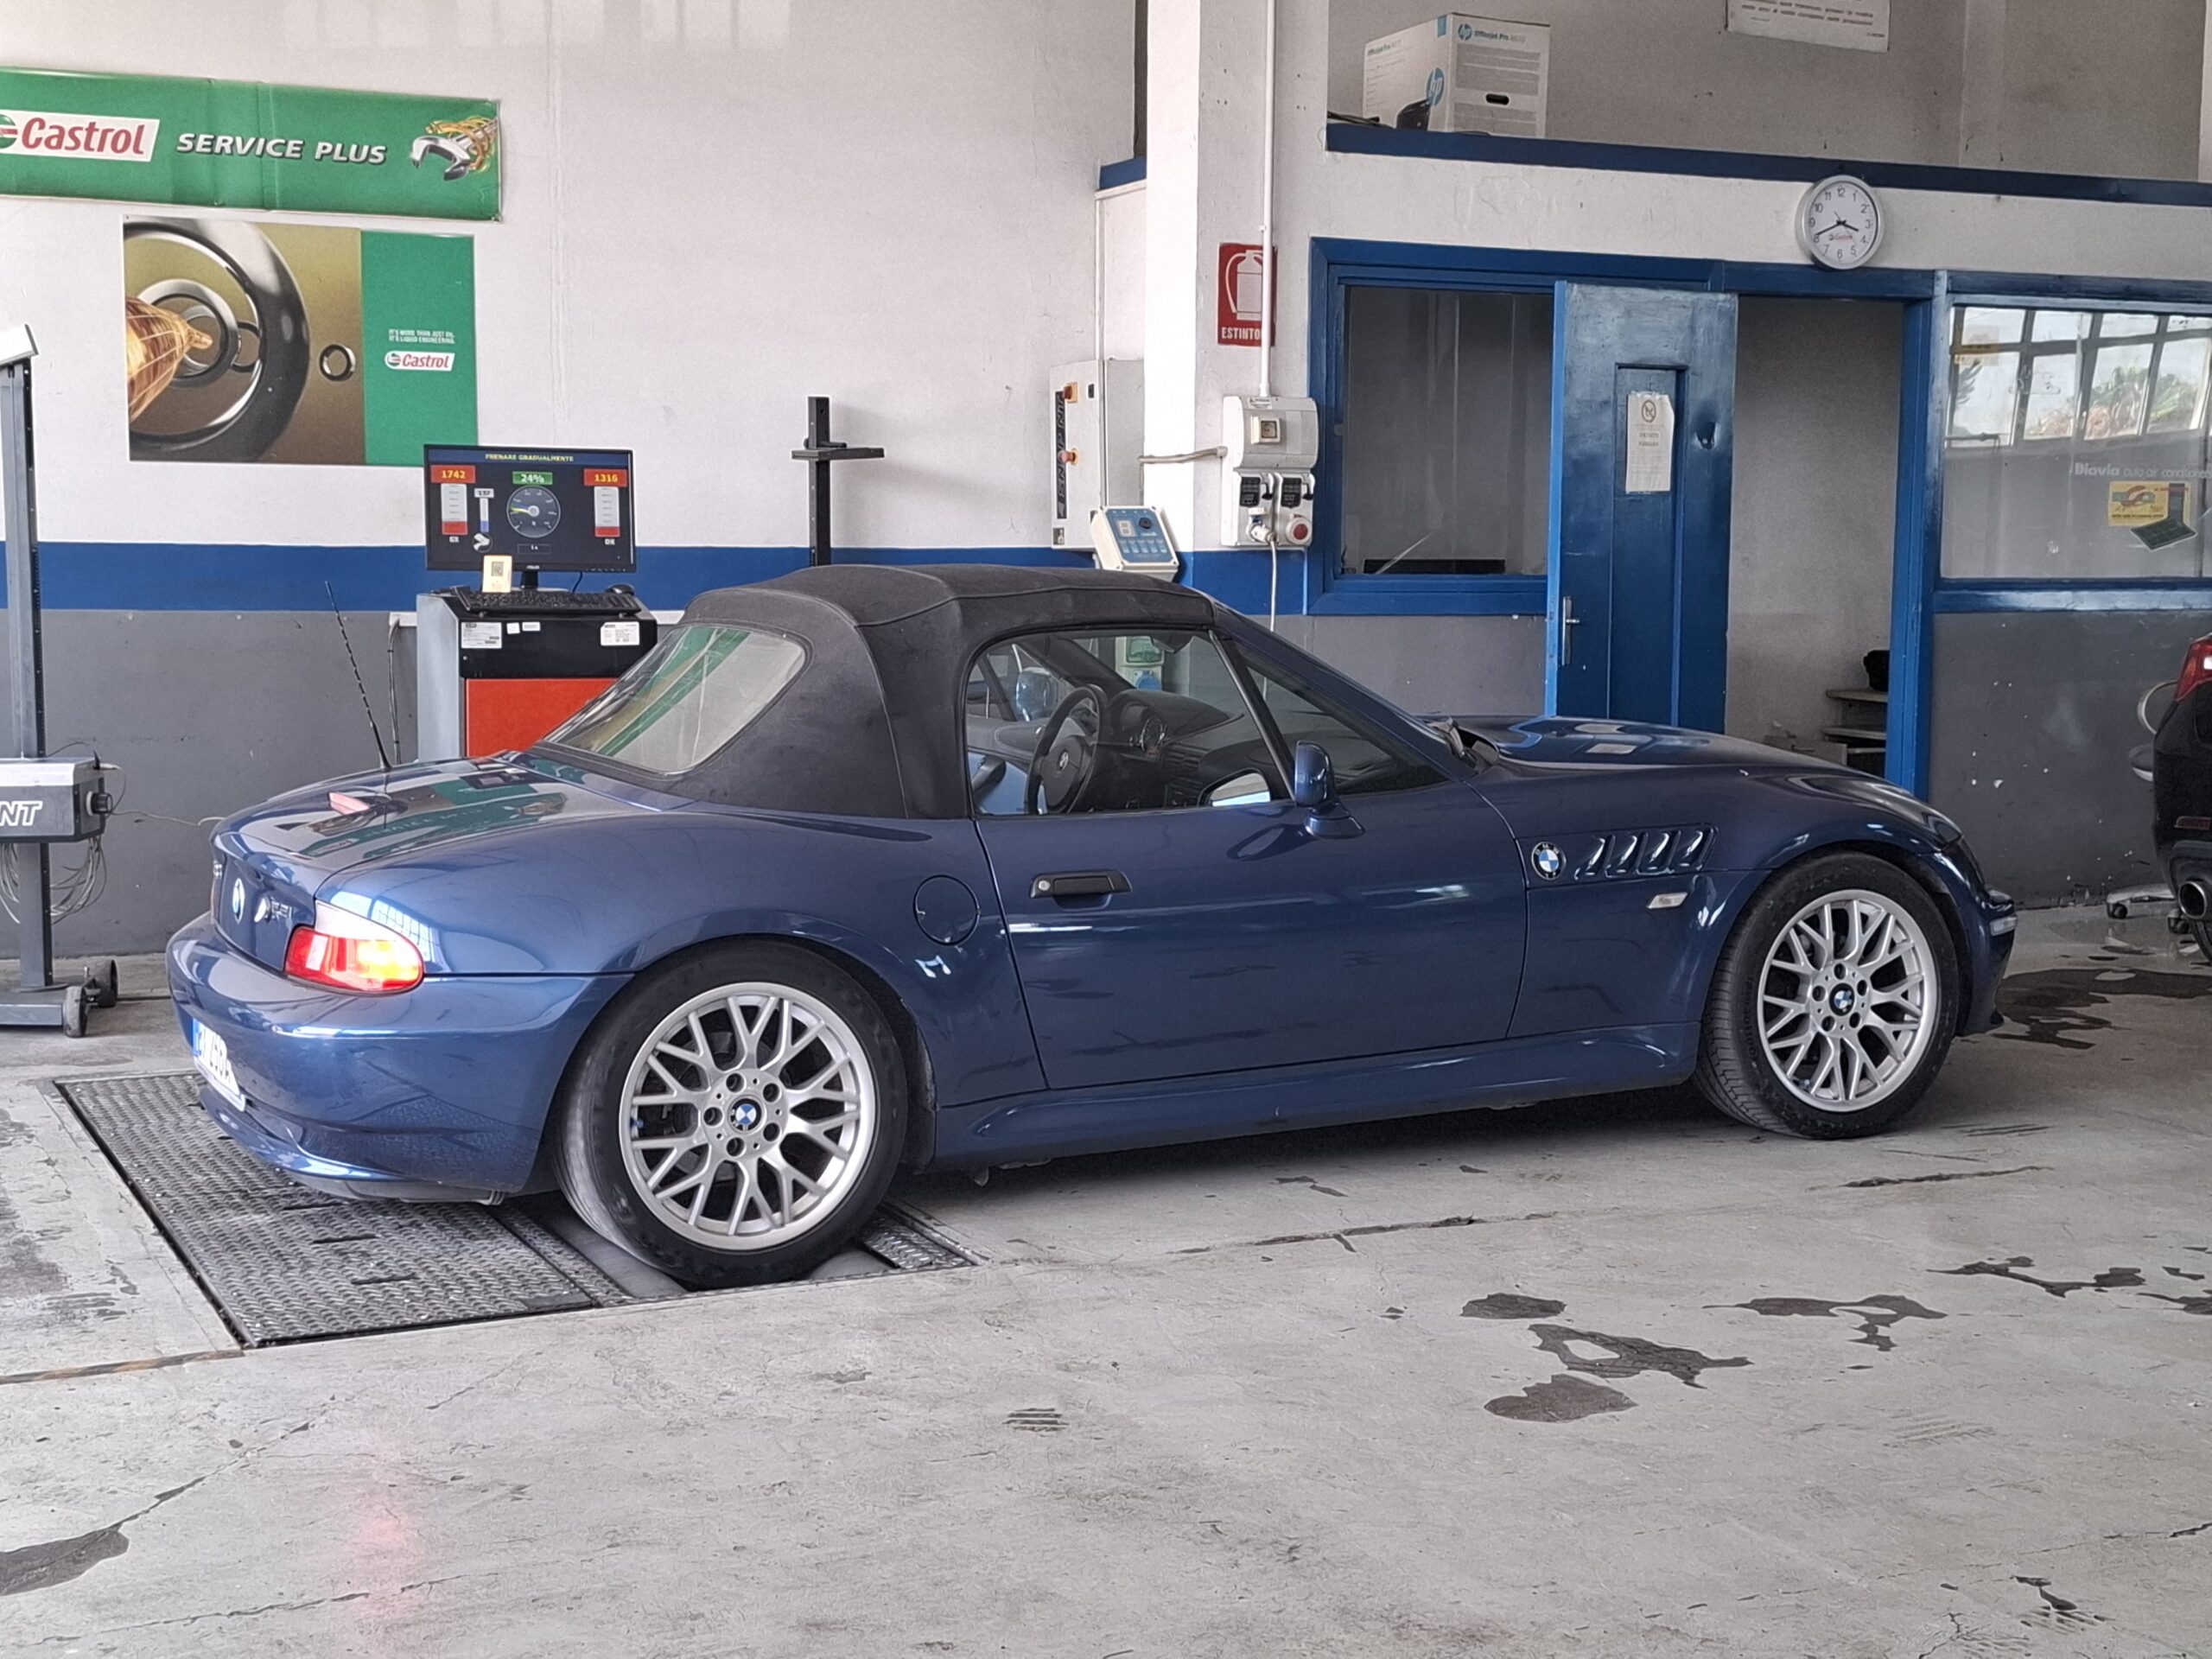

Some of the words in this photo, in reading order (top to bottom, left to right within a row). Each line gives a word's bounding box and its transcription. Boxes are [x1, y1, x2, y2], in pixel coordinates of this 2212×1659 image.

[22, 118, 145, 155] Castrol
[176, 132, 304, 159] SERVICE
[315, 141, 388, 165] PLUS
[1824, 191, 1831, 200] 11
[1838, 188, 1846, 198] 12
[1853, 193, 1857, 202] 1
[1815, 202, 1823, 213] 10
[1860, 204, 1867, 213] 2
[1809, 217, 1815, 227] 9
[1865, 219, 1871, 229] 3
[1860, 235, 1866, 244] 4
[1823, 244, 1829, 256] 7
[1837, 248, 1843, 258] 6
[1850, 245, 1857, 256] 5
[1221, 327, 1262, 340] ESTINTO
[402, 353, 448, 368] Castrol
[2075, 462, 2120, 476] Diavia
[441, 470, 466, 479] 1742
[520, 474, 545, 483] 24%
